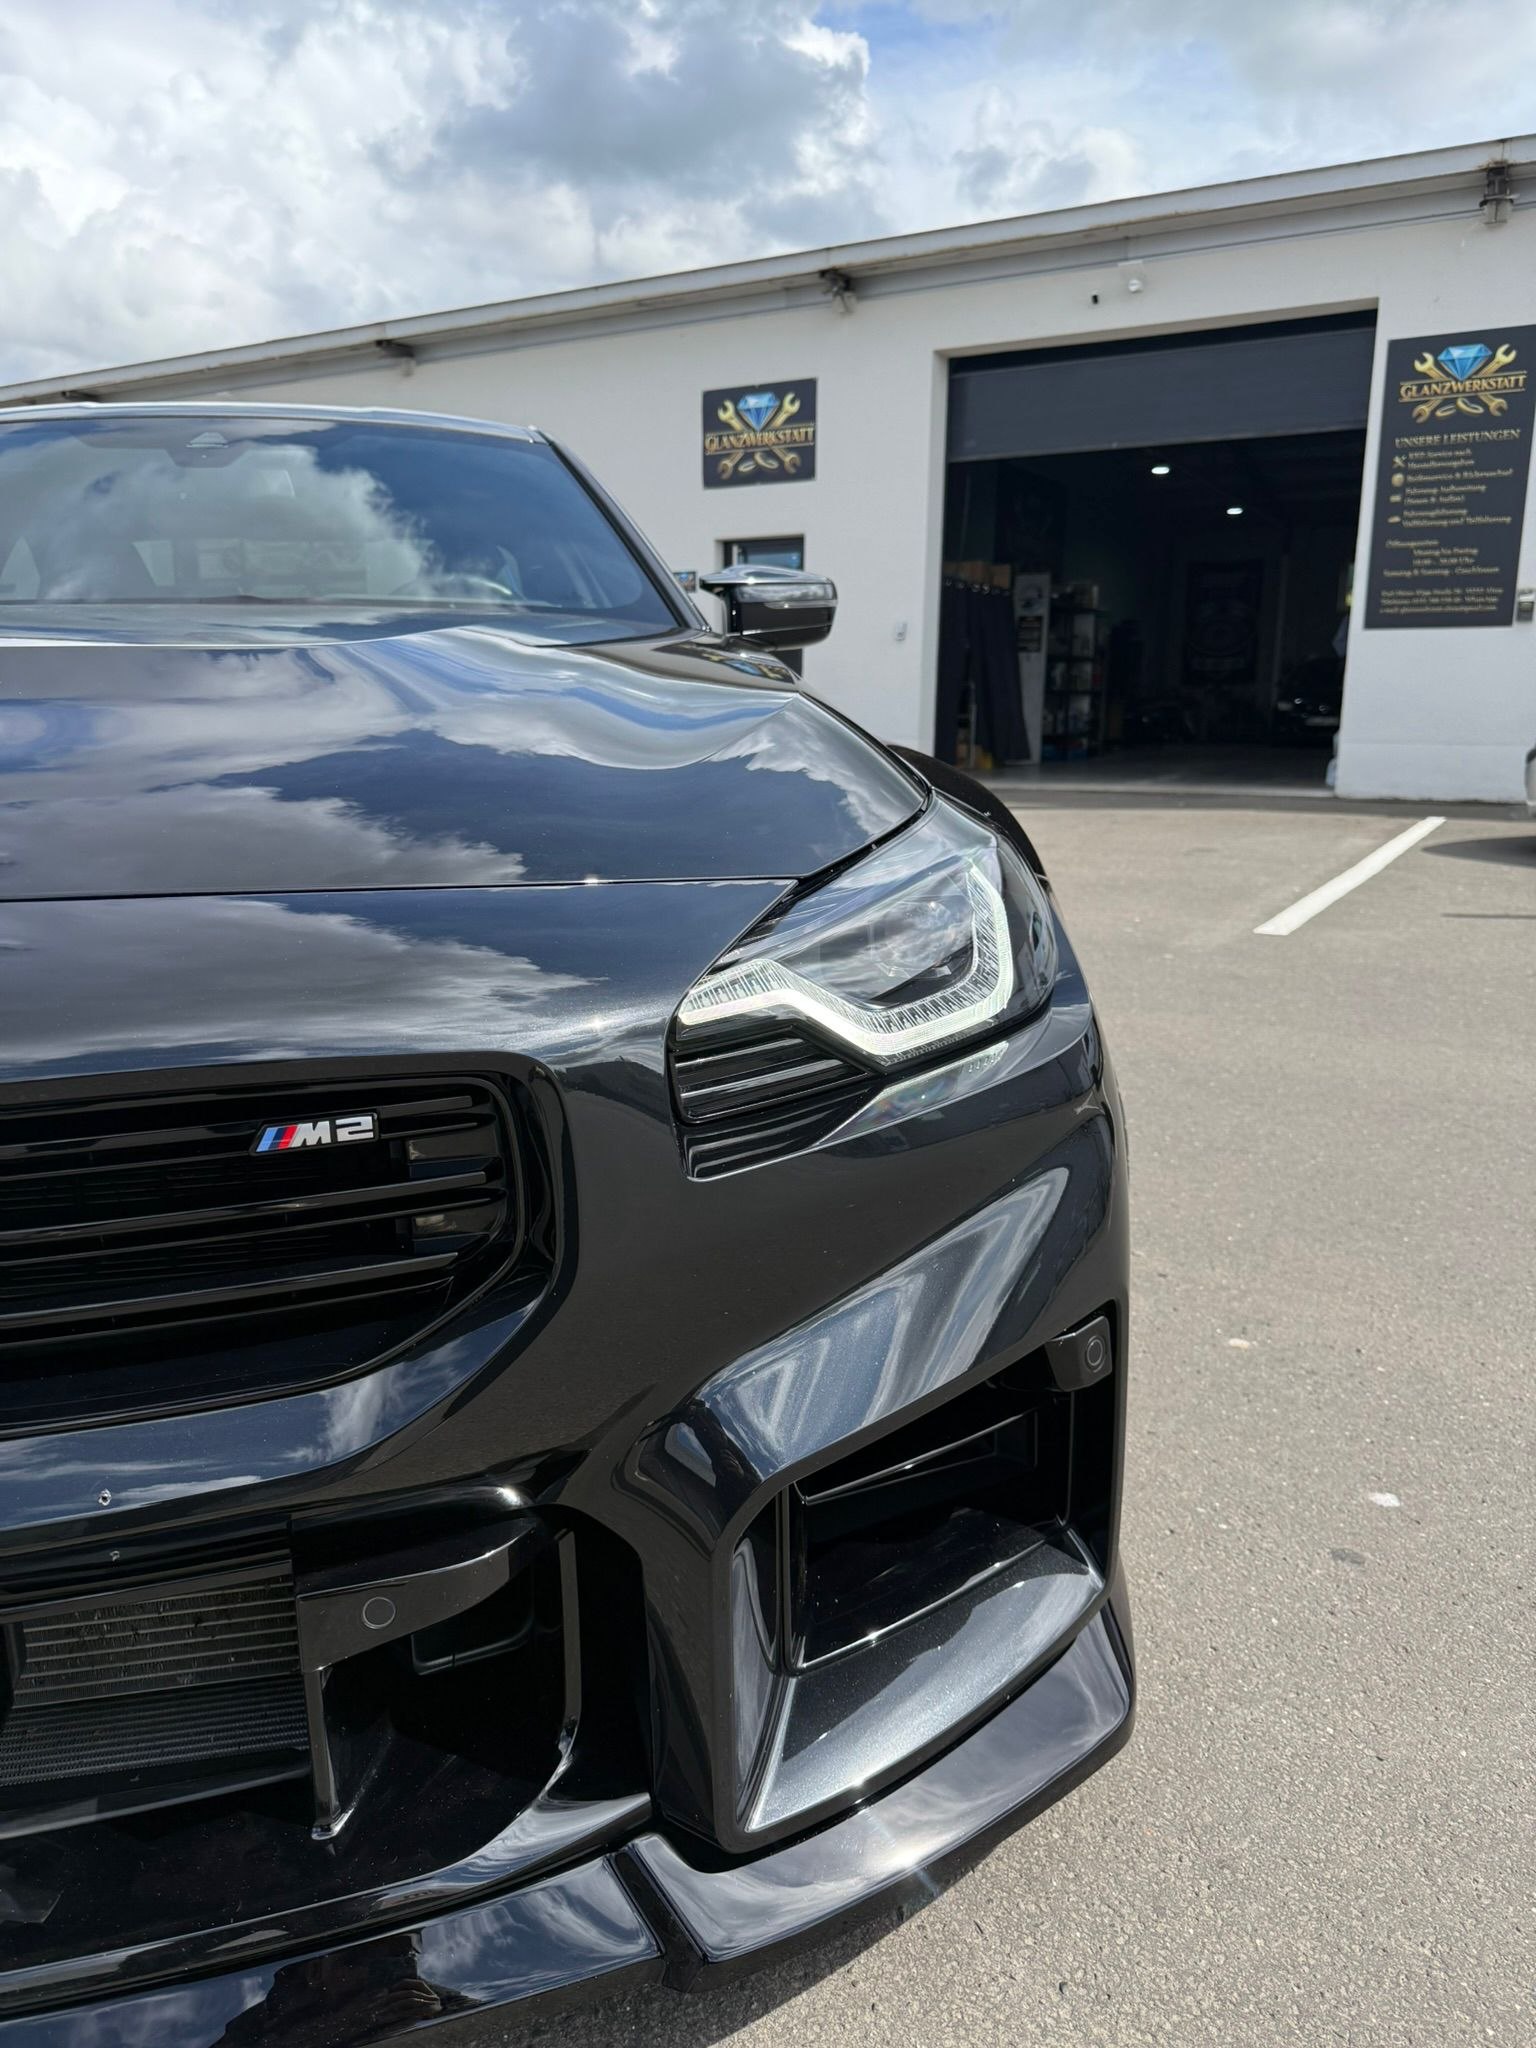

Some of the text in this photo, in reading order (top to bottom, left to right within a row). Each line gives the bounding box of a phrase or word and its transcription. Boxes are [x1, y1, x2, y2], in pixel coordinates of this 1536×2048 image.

[1400, 375, 1526, 398] GLANZWERKSTATT
[1394, 429, 1521, 449] UNSERE LEISTUNGEN
[290, 1116, 374, 1148] M2
